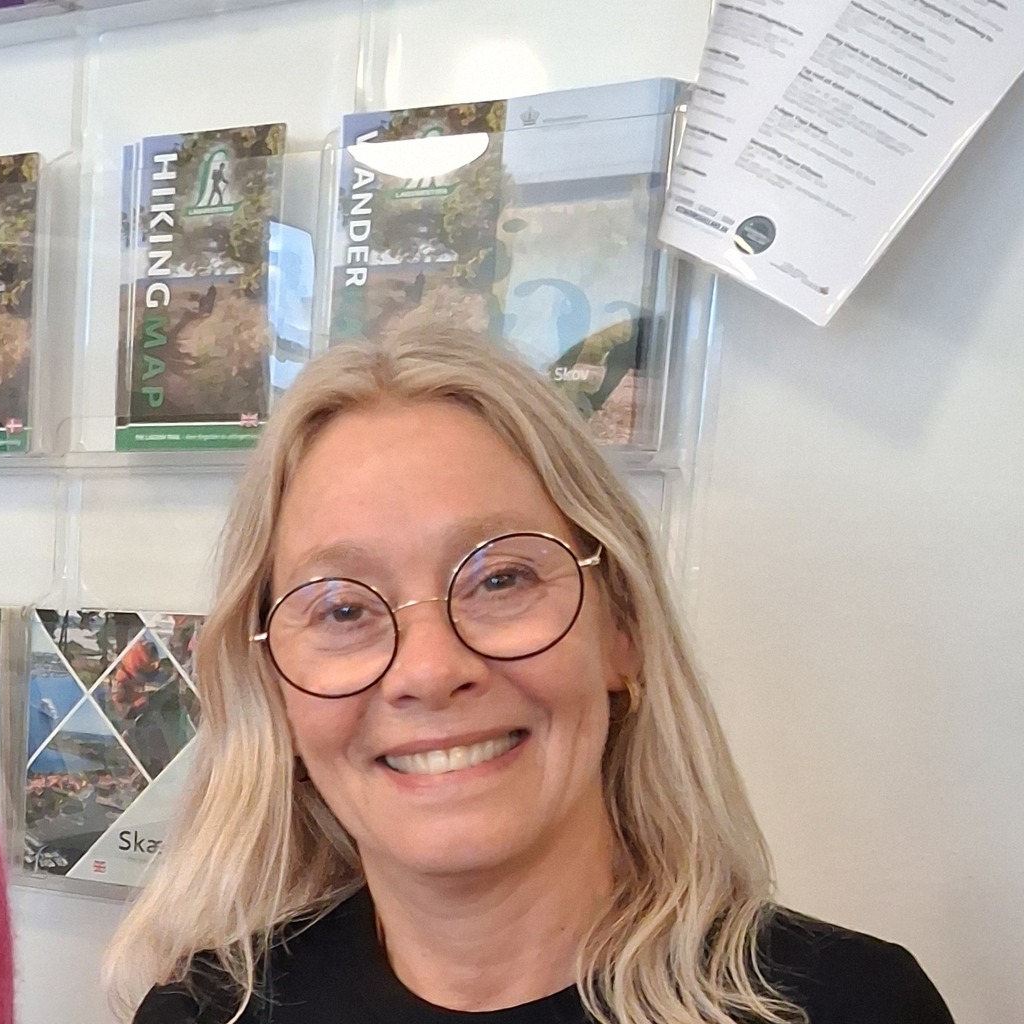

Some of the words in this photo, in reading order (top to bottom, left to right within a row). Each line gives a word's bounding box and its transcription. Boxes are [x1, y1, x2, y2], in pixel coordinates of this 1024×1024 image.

[145, 153, 178, 308] HIKING
[141, 317, 167, 408] MAP
[554, 367, 590, 381] Skov
